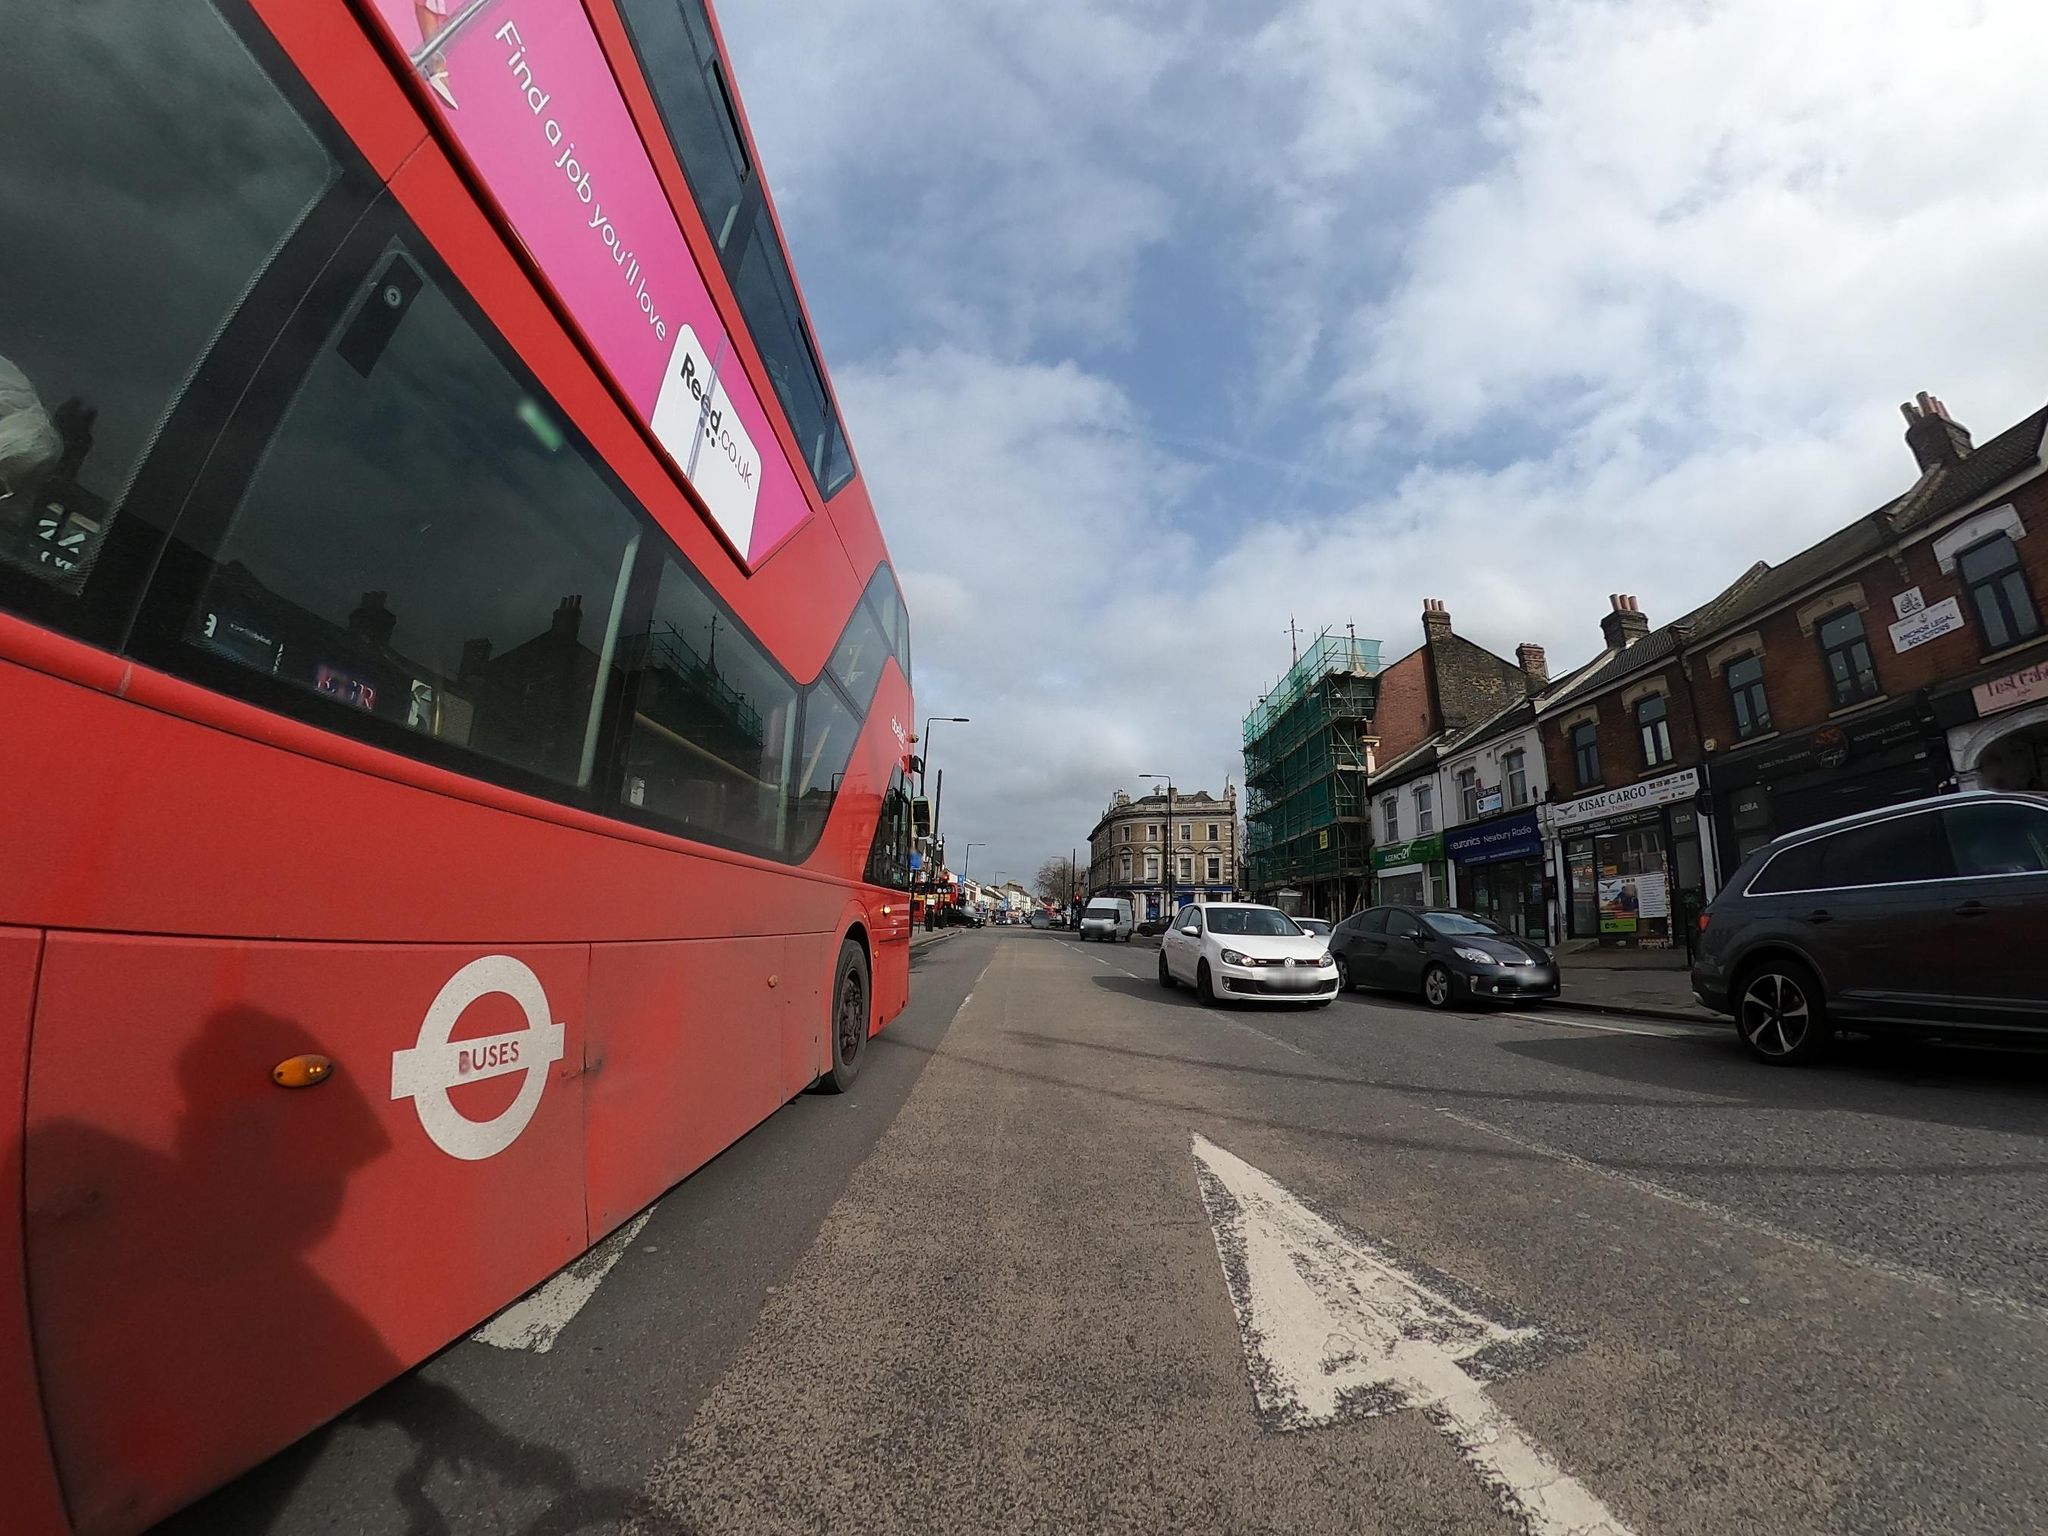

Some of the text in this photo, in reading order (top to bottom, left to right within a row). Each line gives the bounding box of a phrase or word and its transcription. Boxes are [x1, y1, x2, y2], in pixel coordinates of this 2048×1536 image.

[494, 20, 667, 342] Find a job you'll love
[1578, 796, 1606, 813] KISAF
[1608, 785, 1647, 805] CARGO
[1452, 825, 1532, 850] euronics Newbury Radio
